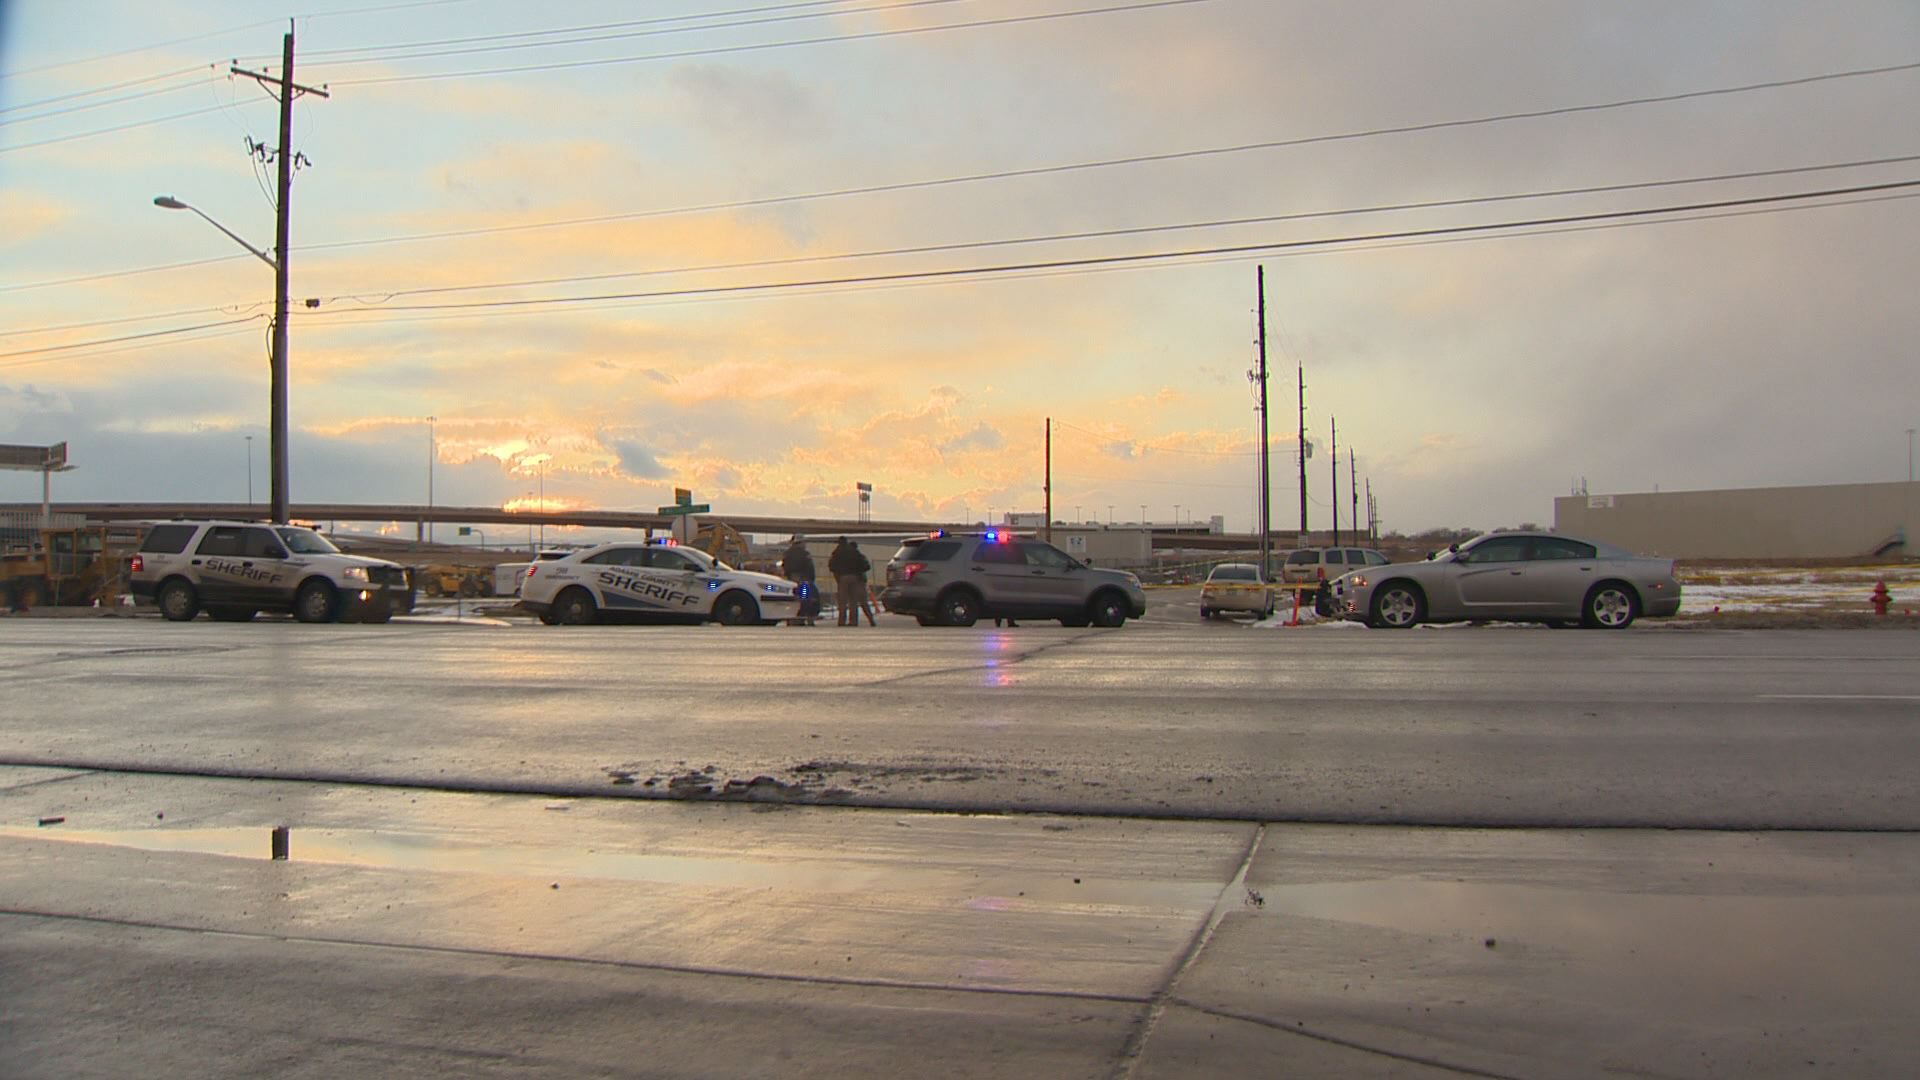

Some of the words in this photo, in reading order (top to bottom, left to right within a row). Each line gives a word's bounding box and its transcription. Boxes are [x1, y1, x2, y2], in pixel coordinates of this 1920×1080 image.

[205, 558, 283, 583] SHERIFF
[640, 573, 679, 588] COUNTY
[598, 571, 700, 606] SHERIFF
